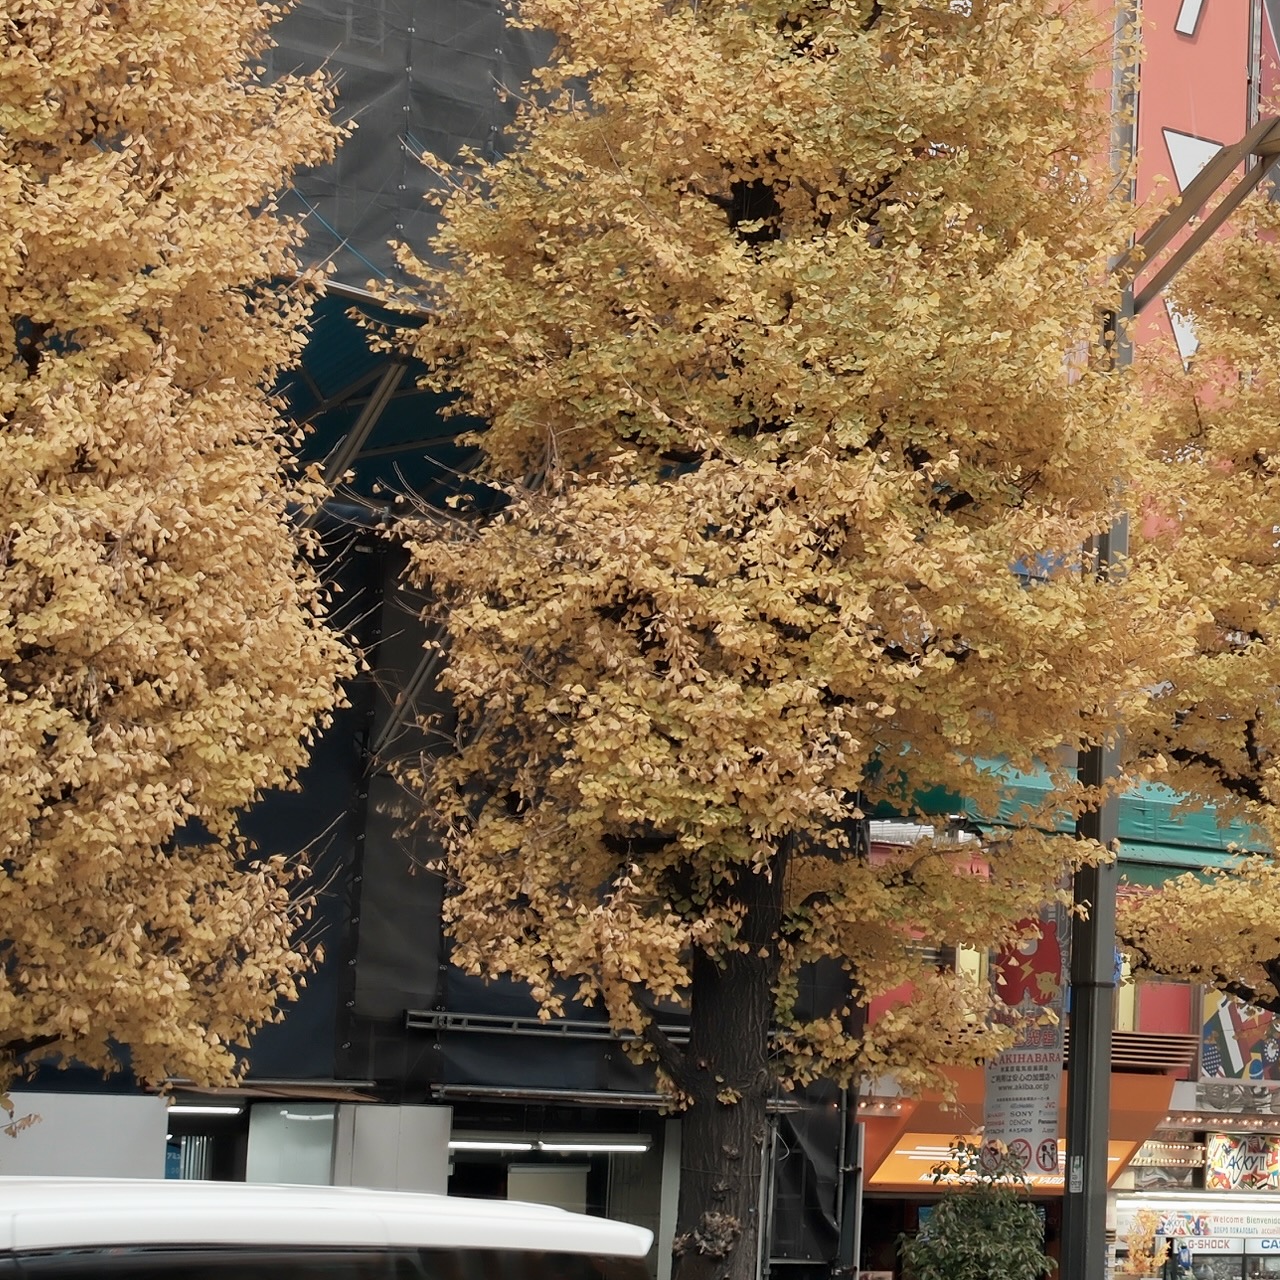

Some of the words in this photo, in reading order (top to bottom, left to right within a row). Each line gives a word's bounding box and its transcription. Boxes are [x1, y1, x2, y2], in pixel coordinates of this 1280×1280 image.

[1000, 1052, 1061, 1065] AKIHABARA
[1213, 1216, 1244, 1224] Welcome
[1188, 1239, 1230, 1249] G-SHOCK
